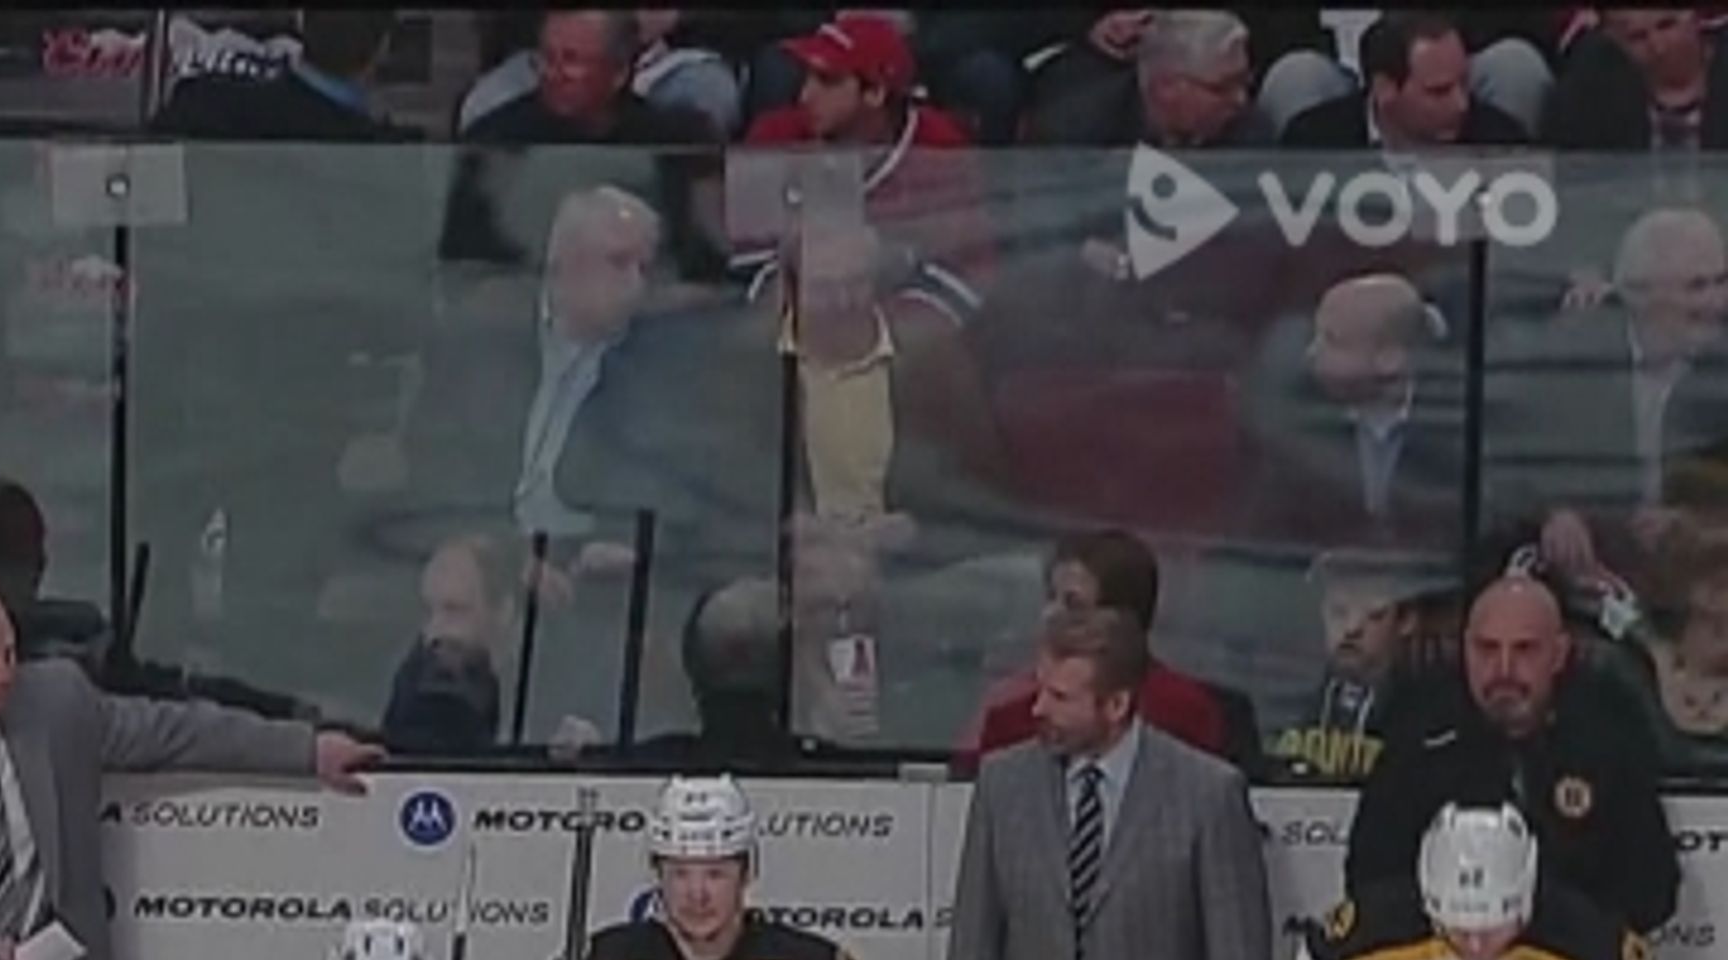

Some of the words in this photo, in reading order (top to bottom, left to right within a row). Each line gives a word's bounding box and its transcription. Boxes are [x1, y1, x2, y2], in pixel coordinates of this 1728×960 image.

[133, 801, 320, 828] SOLUTIONS
[474, 809, 646, 833] MOTORO
[760, 813, 894, 838] UTIONS
[133, 896, 352, 921] MOTOROLA
[363, 900, 550, 925] SOLUIONS
